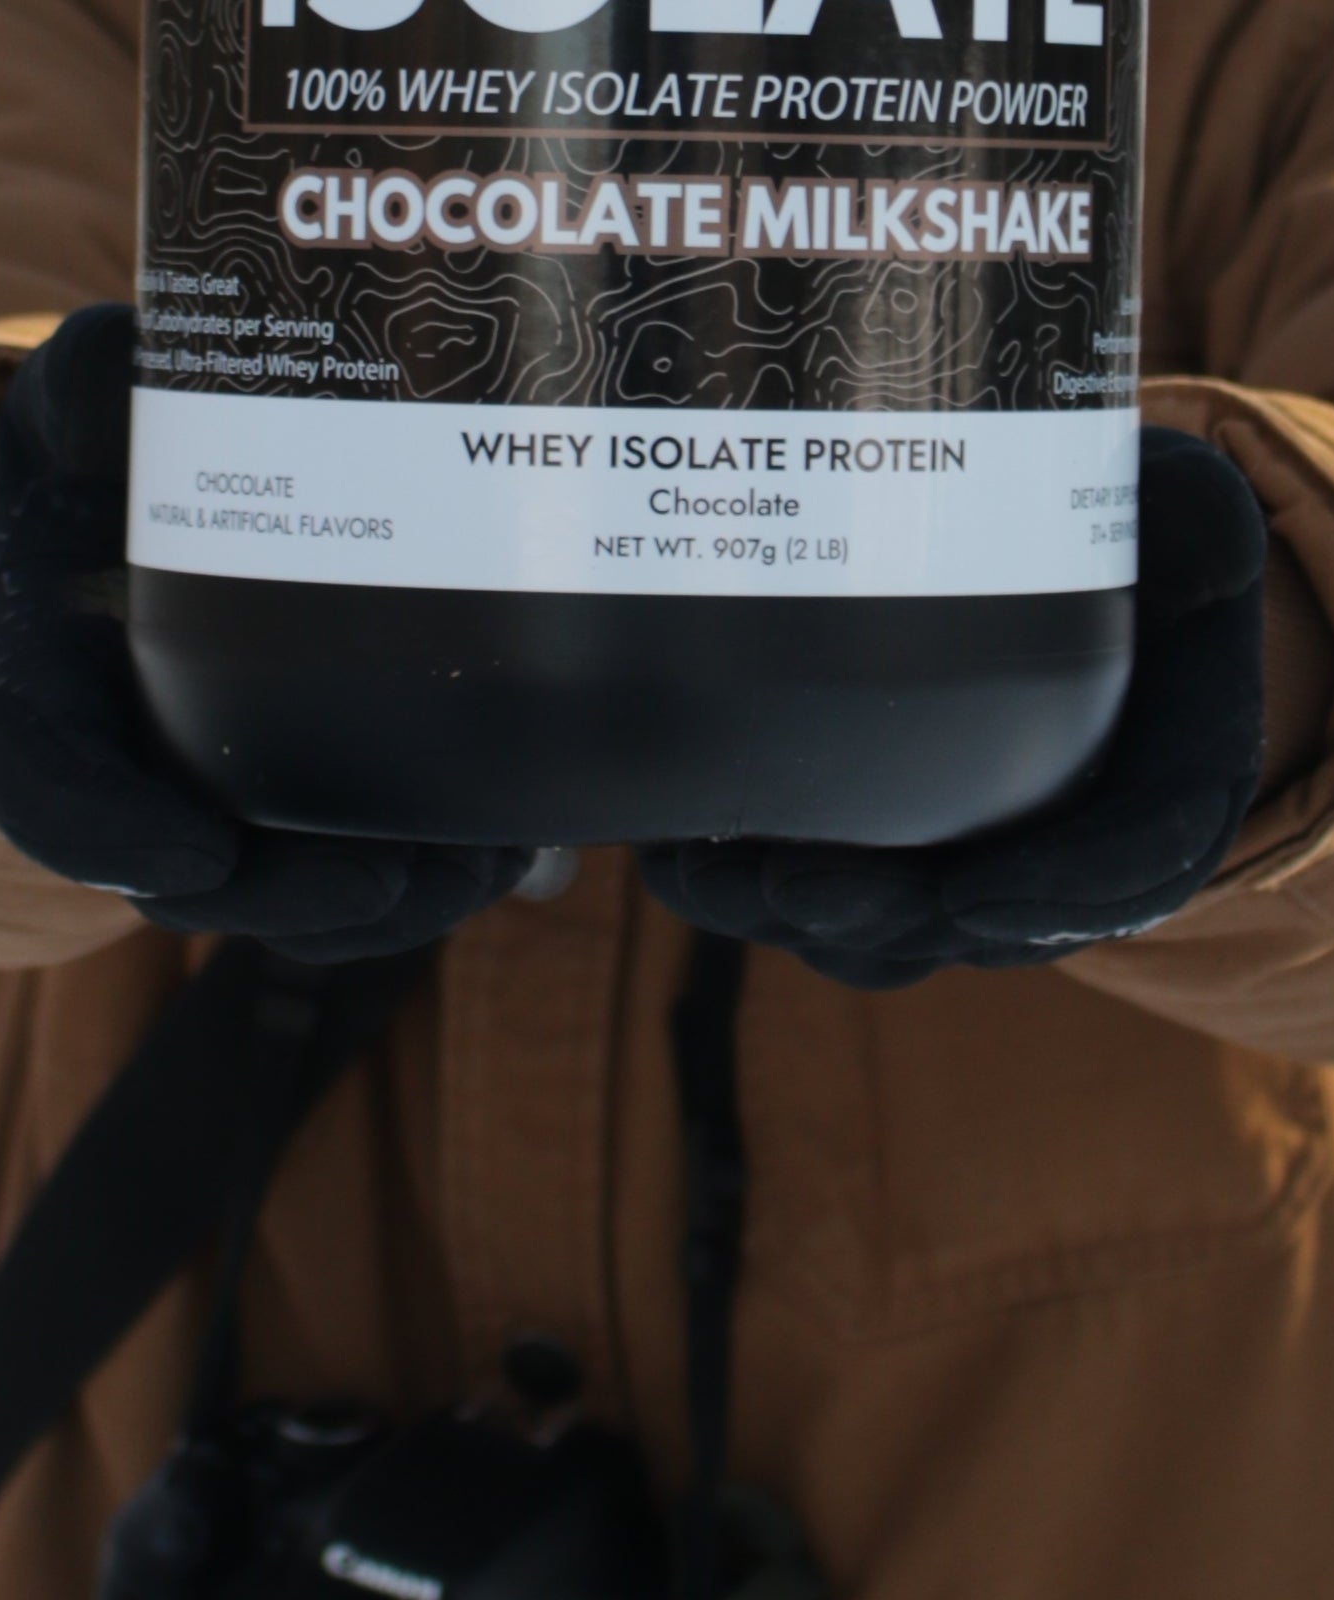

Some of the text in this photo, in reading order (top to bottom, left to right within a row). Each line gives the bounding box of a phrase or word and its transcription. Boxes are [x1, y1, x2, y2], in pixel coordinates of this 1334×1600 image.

[285, 67, 1089, 128] 100% WHEY ISOLATE PROTEIN POWDER
[281, 174, 1091, 255] CHOCOLATE MILKSHAKE
[201, 273, 239, 296] Great
[233, 317, 262, 341] per
[264, 314, 335, 346] Serving
[173, 348, 263, 377] Ultra-Filtered
[267, 355, 317, 384] Whey
[323, 356, 400, 383] Protein
[460, 430, 966, 473] WHEY ISOLATE PROTEIN
[195, 470, 295, 499] CHOCOLATE
[648, 486, 801, 518] Chocolate
[196, 507, 207, 529] &
[210, 509, 294, 536] ARTIFICIAL
[299, 515, 395, 541] FLAVORS
[593, 536, 849, 566] NET WT. 907g (2 LB)
